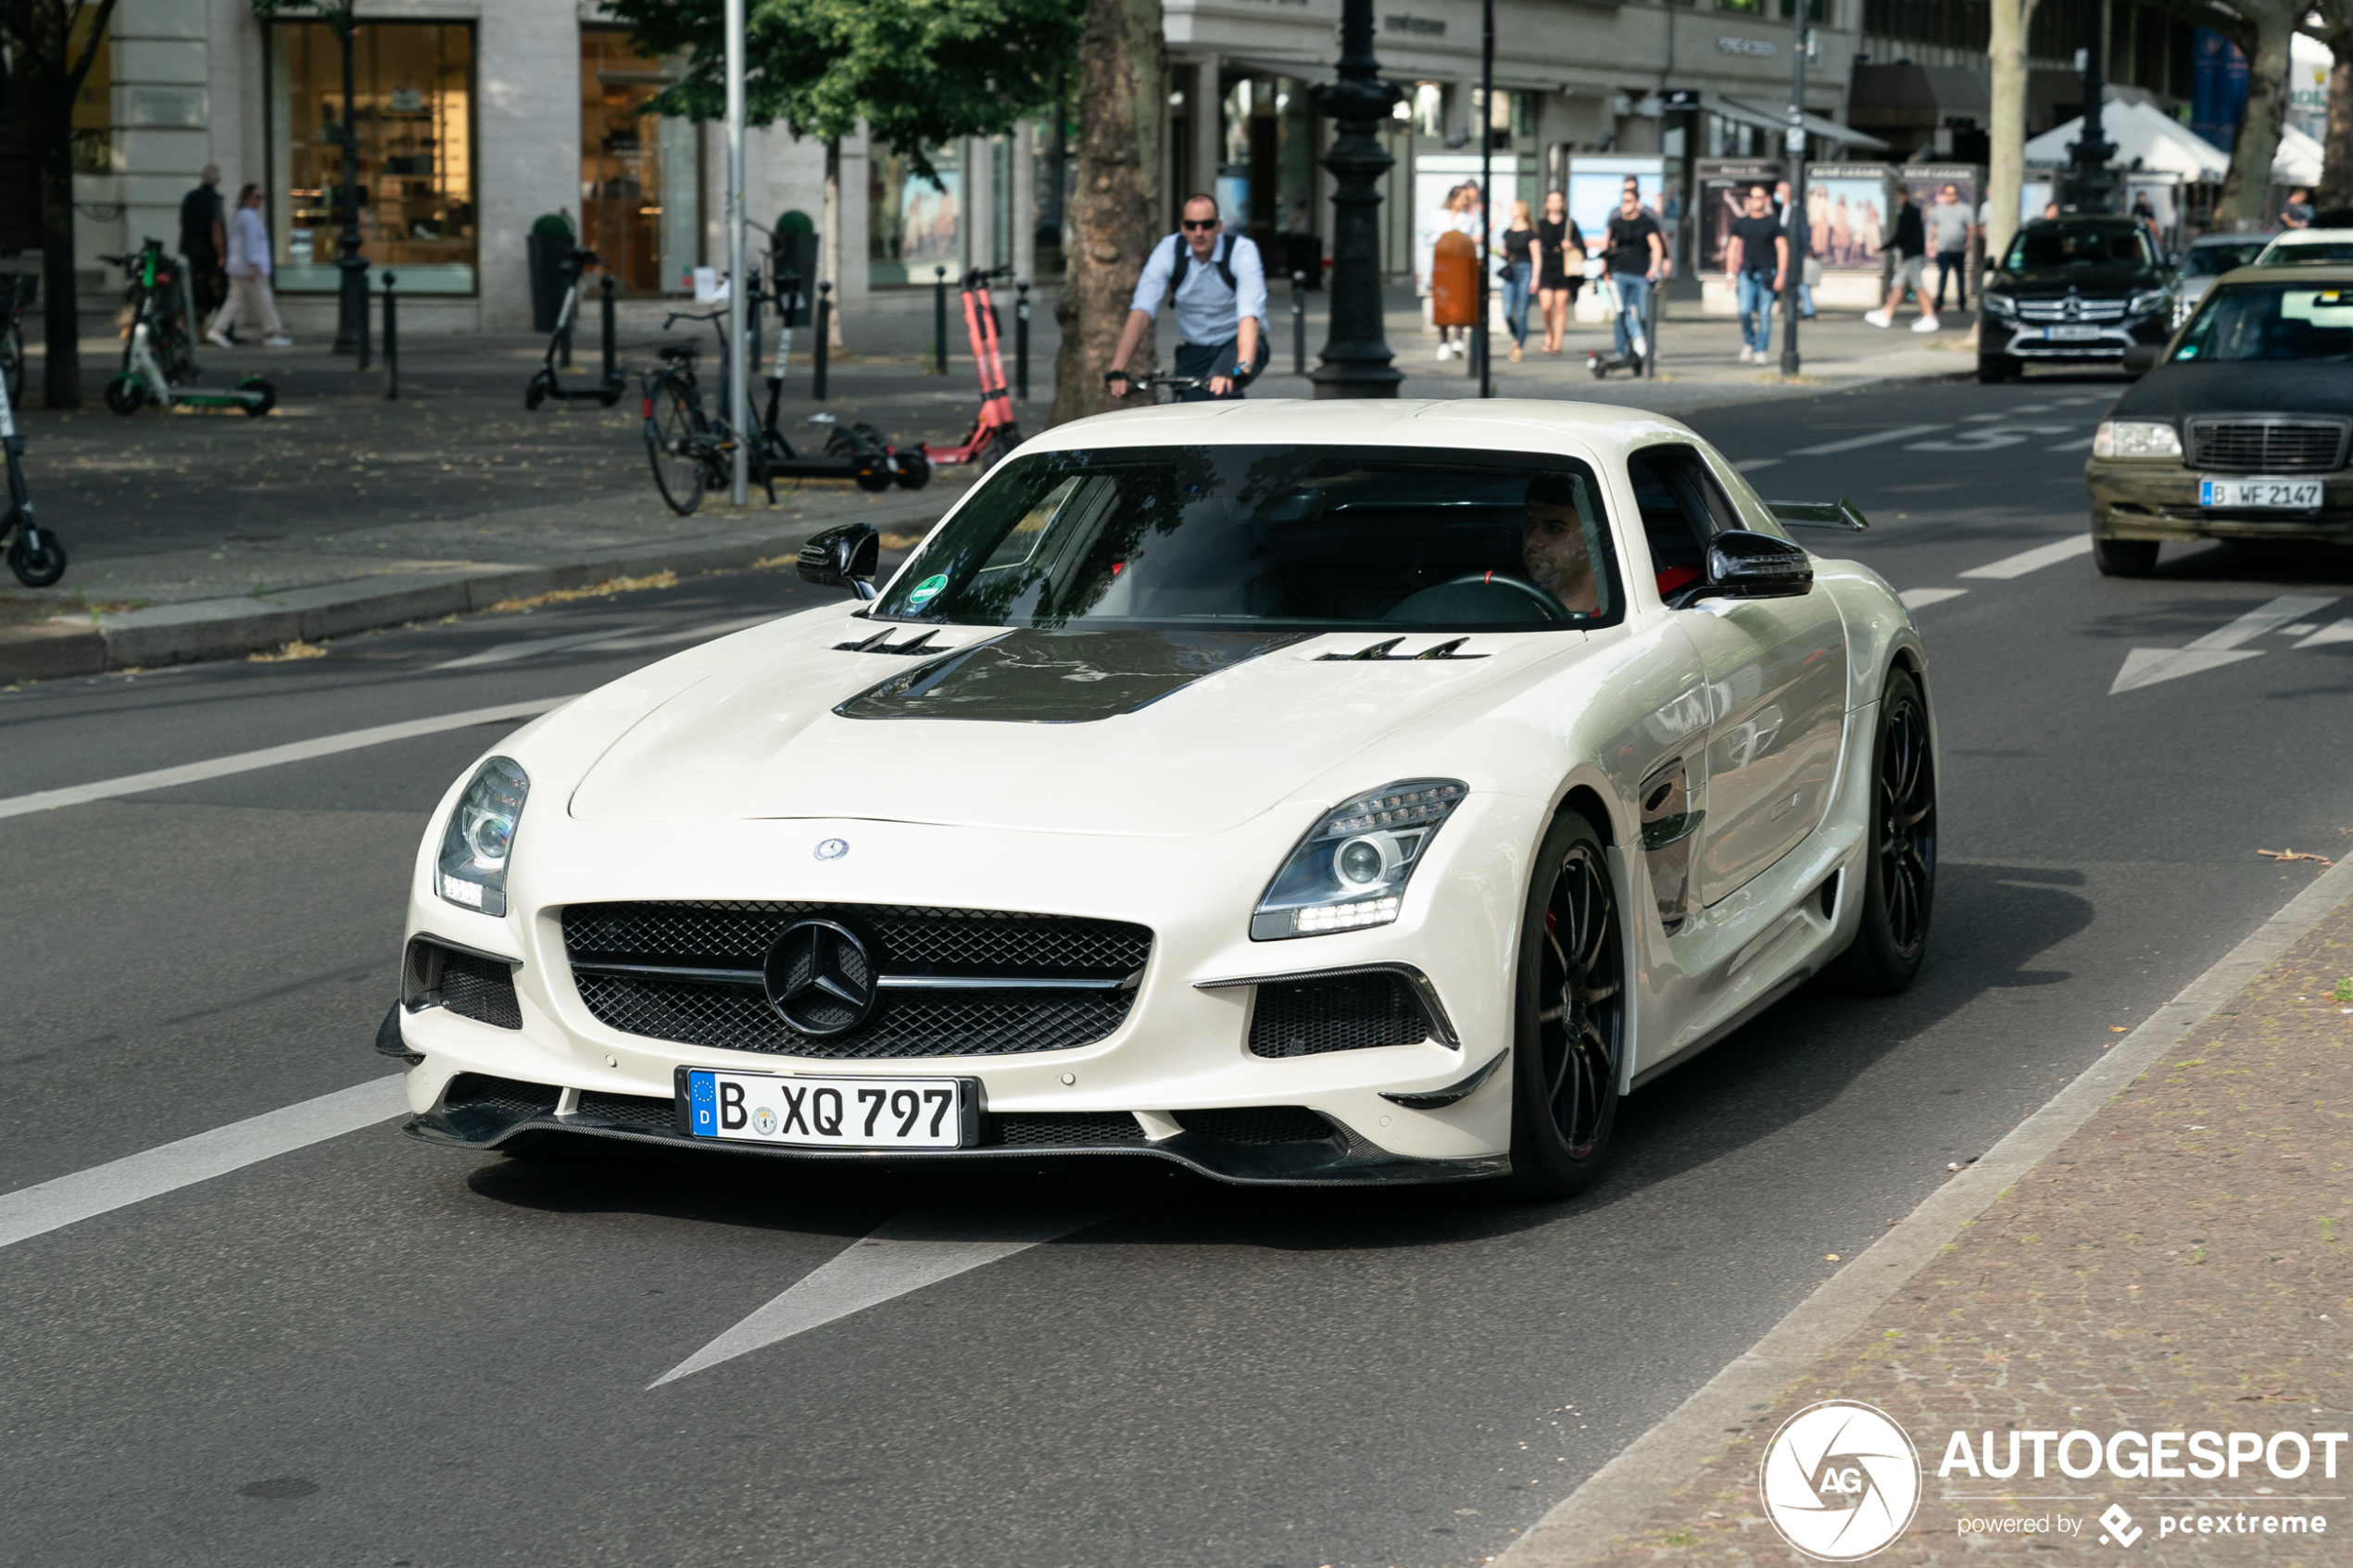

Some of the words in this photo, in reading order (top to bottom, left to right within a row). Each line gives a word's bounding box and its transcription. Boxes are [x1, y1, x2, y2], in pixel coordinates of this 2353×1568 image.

[2214, 485, 2225, 504] B
[2240, 485, 2264, 503] WF
[2270, 485, 2318, 505] 2147
[700, 1110, 710, 1124] D
[720, 1082, 748, 1130] B
[781, 1085, 843, 1136] XQ
[858, 1088, 952, 1137] 797
